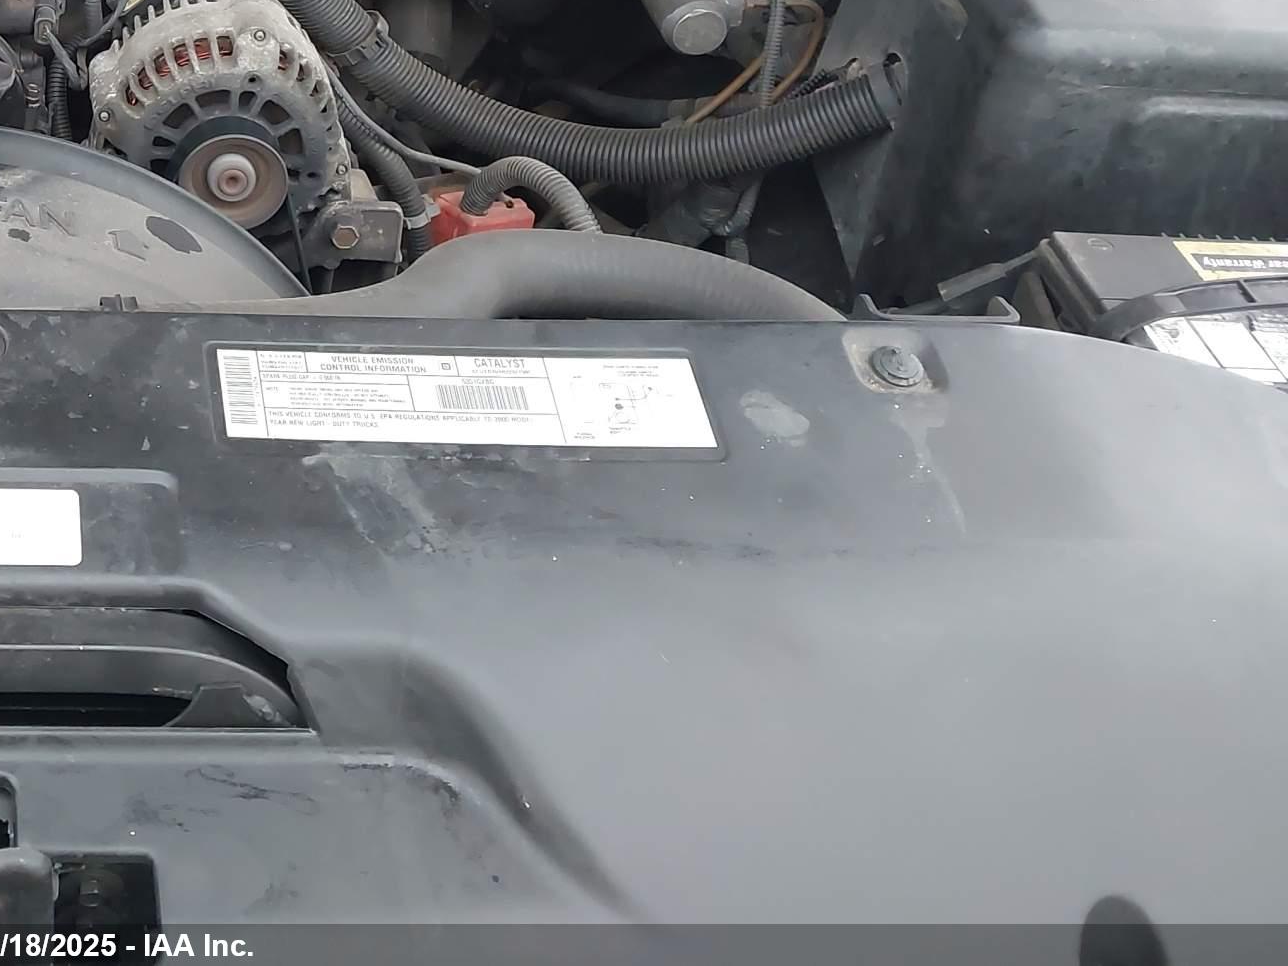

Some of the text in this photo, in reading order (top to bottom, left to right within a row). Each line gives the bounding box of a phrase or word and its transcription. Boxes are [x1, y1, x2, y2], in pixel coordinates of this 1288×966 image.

[1203, 256, 1266, 269] Warranty
[331, 356, 369, 364] VEHICLE
[474, 358, 525, 368] CATALYST
[364, 365, 426, 373] INFORMATION
